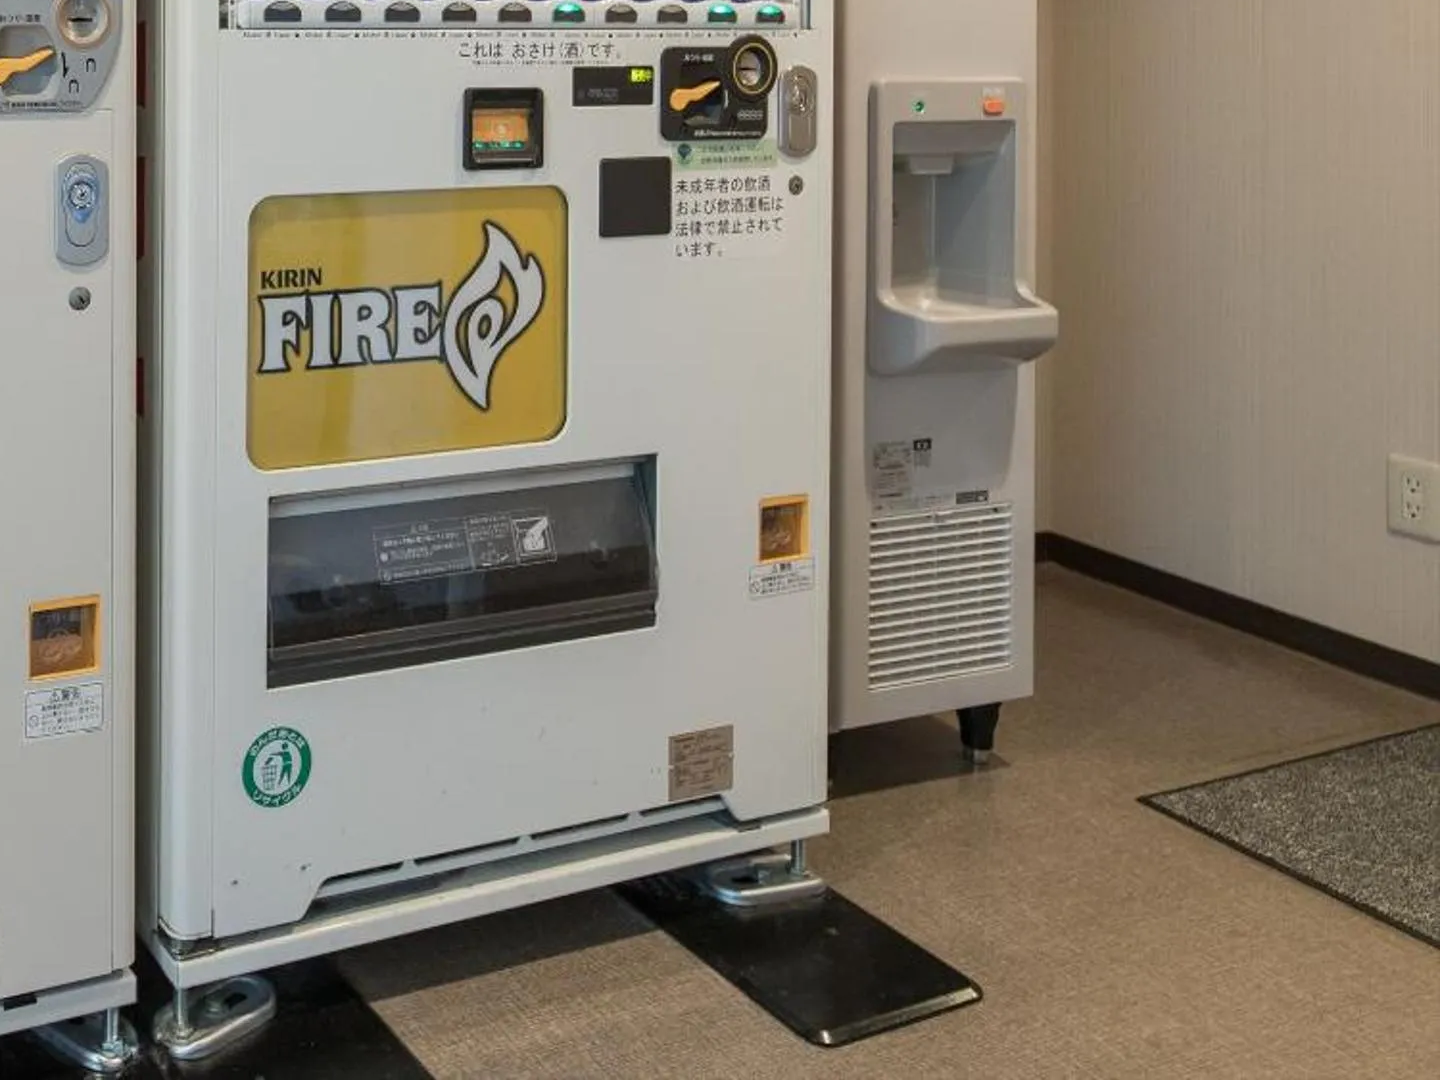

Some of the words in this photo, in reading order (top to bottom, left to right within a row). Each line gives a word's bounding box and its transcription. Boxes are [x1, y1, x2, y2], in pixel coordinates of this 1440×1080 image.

[459, 43, 503, 59] これは
[675, 176, 772, 195] 未成年者の飲酒
[675, 196, 784, 215] および飲酒運転は
[675, 217, 784, 237] 法律で禁止されて
[675, 243, 724, 258] います。
[260, 267, 323, 290] KIRIN
[257, 280, 445, 375] FIRE
